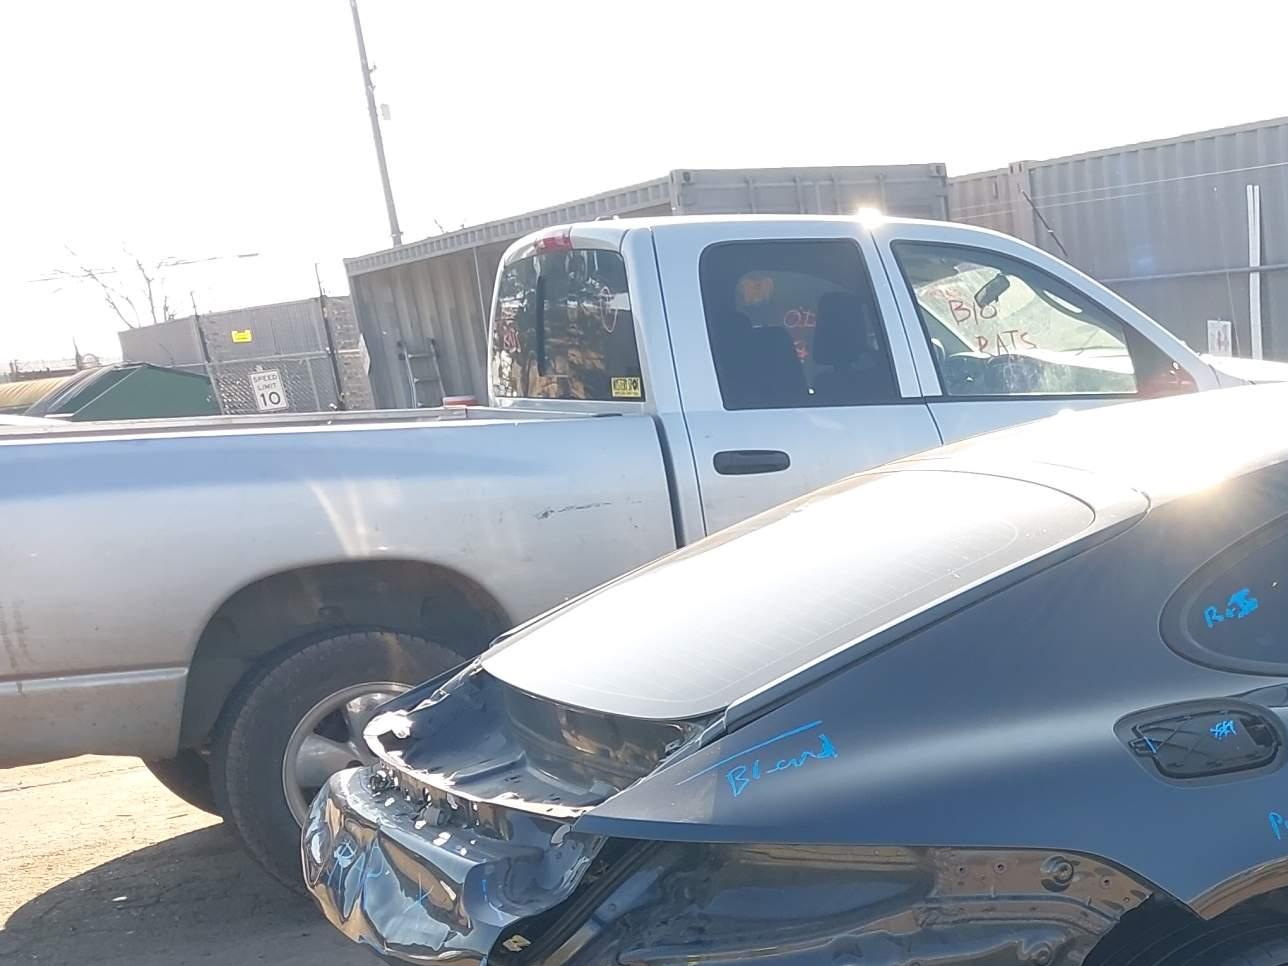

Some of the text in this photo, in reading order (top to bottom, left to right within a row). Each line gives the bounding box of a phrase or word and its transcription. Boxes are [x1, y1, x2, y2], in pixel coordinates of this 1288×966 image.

[253, 374, 278, 382] SPEED
[257, 382, 277, 390] LIMIT
[260, 391, 281, 407] 10
